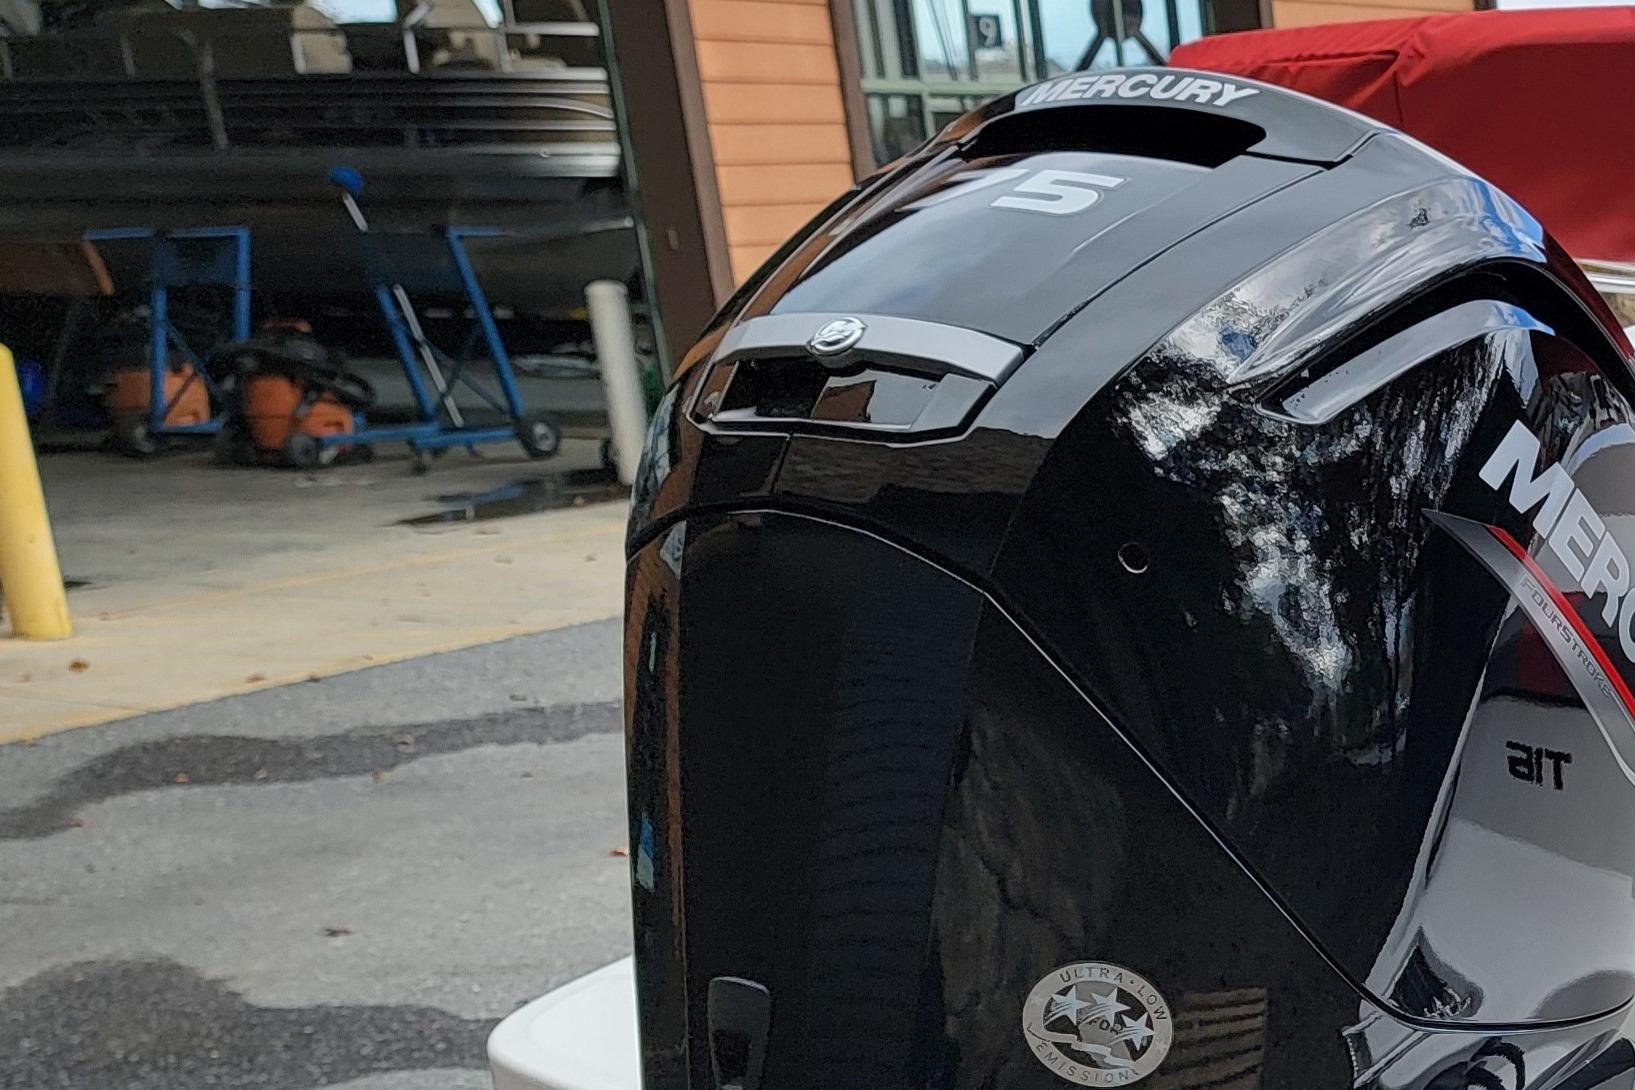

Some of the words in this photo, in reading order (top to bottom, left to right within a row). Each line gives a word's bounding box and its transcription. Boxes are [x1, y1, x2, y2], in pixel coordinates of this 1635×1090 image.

[1019, 73, 1262, 107] MERCURY
[1520, 575, 1613, 697] FOURSTROKE
[1059, 966, 1124, 984] ULTRA
[1135, 984, 1168, 1021] LOW
